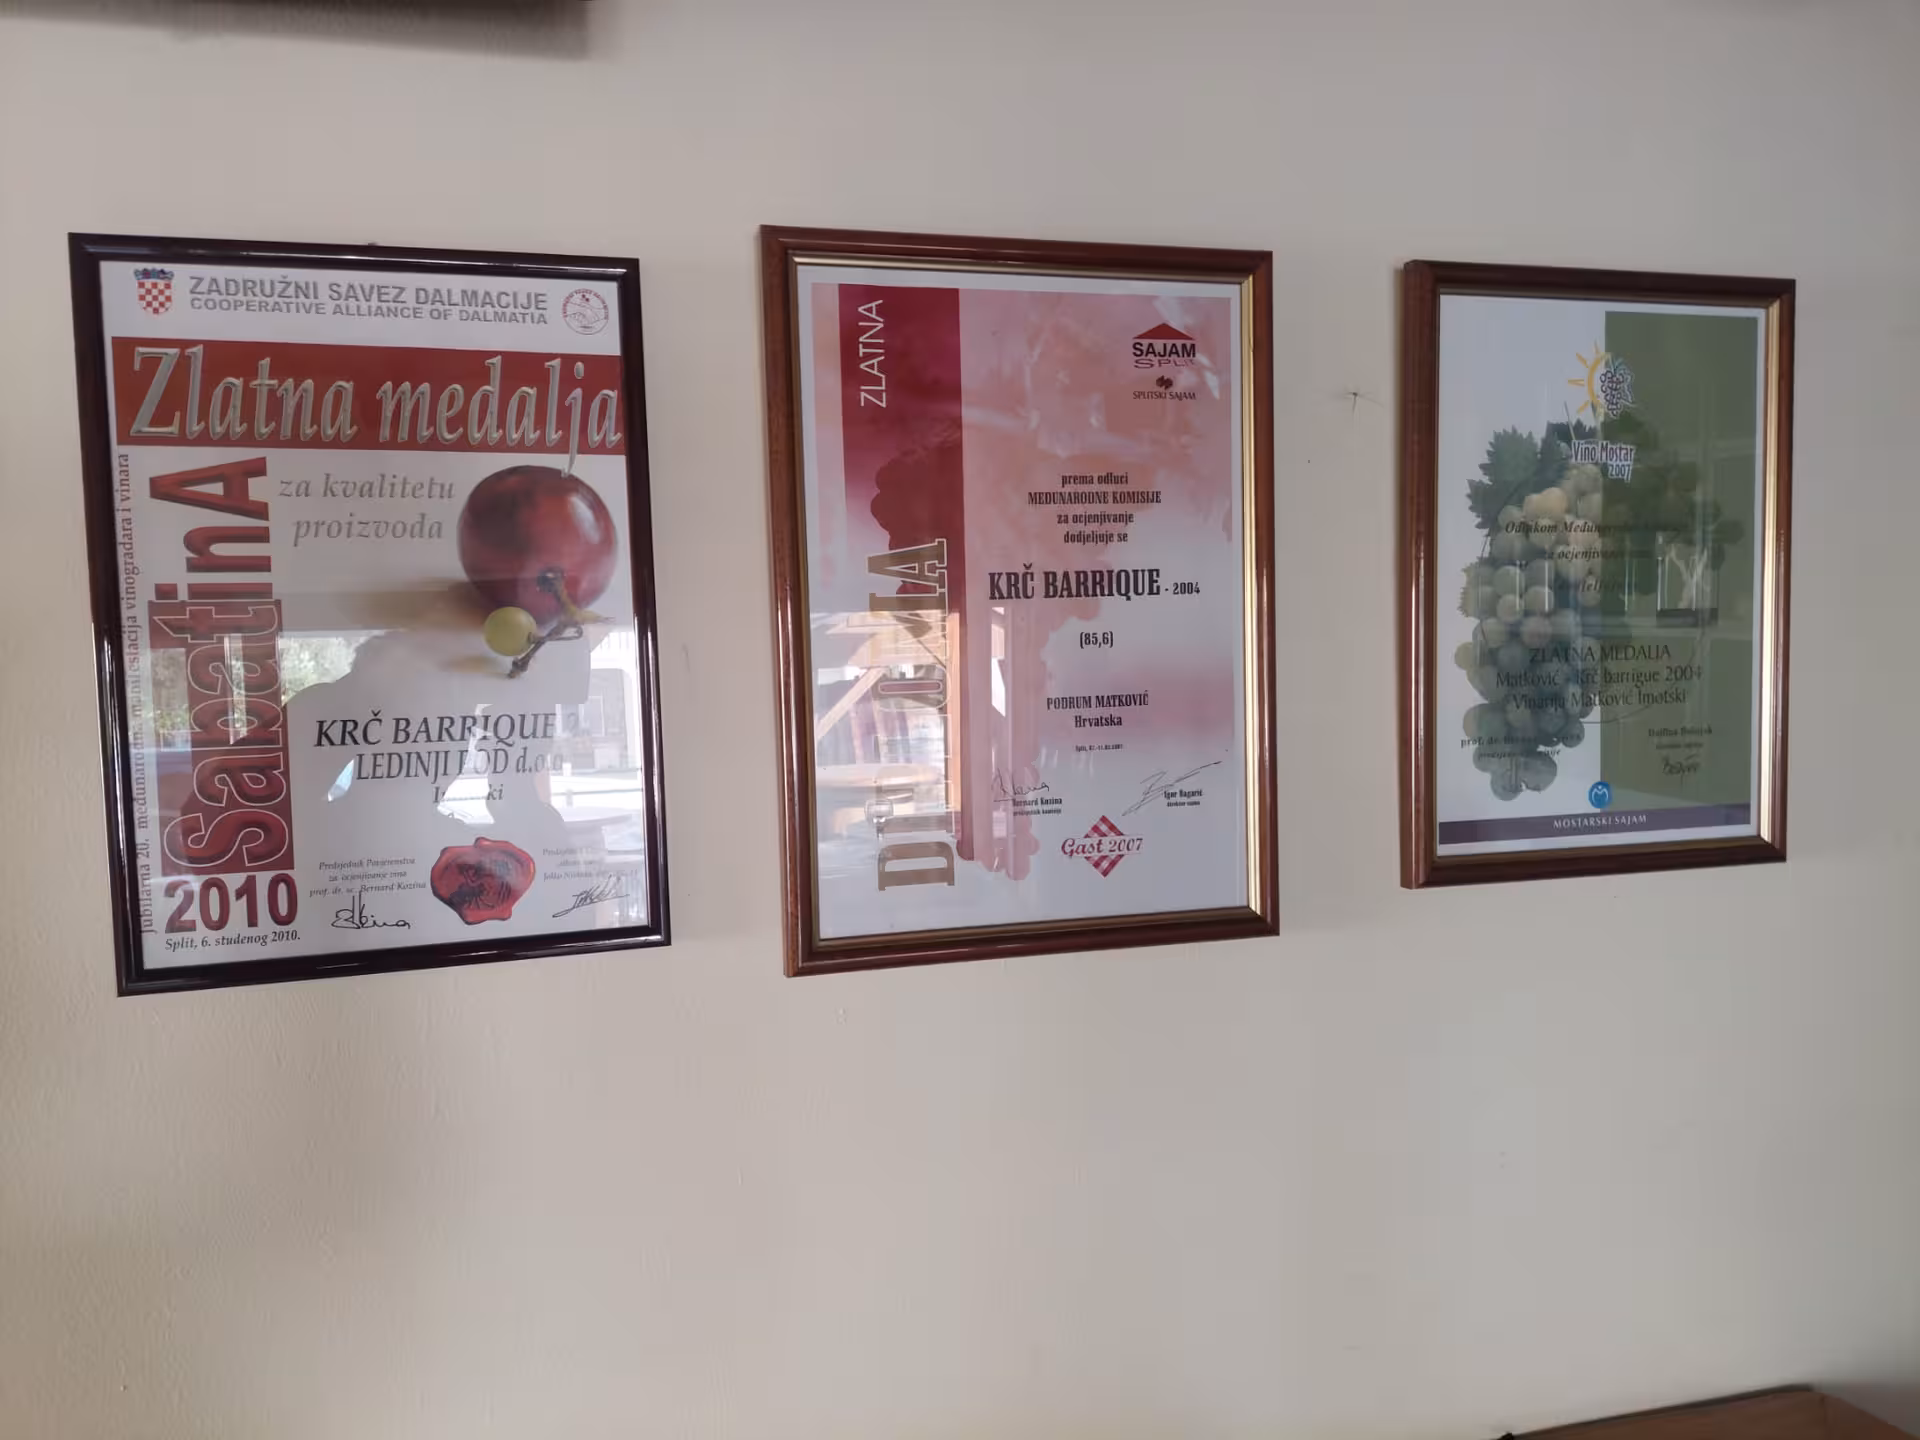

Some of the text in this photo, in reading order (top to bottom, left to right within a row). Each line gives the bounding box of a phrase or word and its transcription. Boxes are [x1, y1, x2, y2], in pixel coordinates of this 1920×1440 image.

[189, 274, 319, 300] ZADRUŽNI
[328, 281, 407, 305] SAVEZ
[415, 287, 549, 311] DALMACIJE
[190, 297, 548, 325] COOPERATIVE ALLIANCE OF DALMATIA
[859, 299, 887, 409] ZLATNA
[1132, 342, 1197, 358] SAJAM
[1132, 390, 1197, 402] SPLITSKI SAJAM
[129, 343, 624, 478] Zlatna medalja
[1573, 441, 1634, 463] Vino Mostar
[114, 453, 131, 502] vinara
[1061, 471, 1129, 488] prema odluci
[1608, 464, 1631, 481] 2007
[277, 473, 456, 499] za kvalitetu
[1112, 490, 1162, 504] KOMISIJE
[293, 512, 444, 547] proizvoda
[1056, 511, 1135, 527] za ocjenjivanje
[1063, 530, 1129, 546] dodjeljuje se
[117, 517, 141, 611] vinogradara
[988, 562, 1035, 601] KRČ
[1042, 568, 1161, 602] BARRIQUE
[1172, 581, 1201, 597] 2004
[1079, 631, 1115, 650] (85,6)
[1046, 689, 1150, 711] PODRUM MATKOVIĆ
[314, 709, 383, 747] KRČ
[391, 711, 557, 749] BARRIQUE
[1074, 713, 1123, 728] Hrvatska
[356, 750, 451, 785] LEDINJI
[1553, 814, 1648, 829] MOSTARSKI SAJAM
[1061, 836, 1145, 859] Gast 2007
[164, 872, 299, 934] 2010
[165, 929, 301, 953] Split, 6. studenog 2010.
